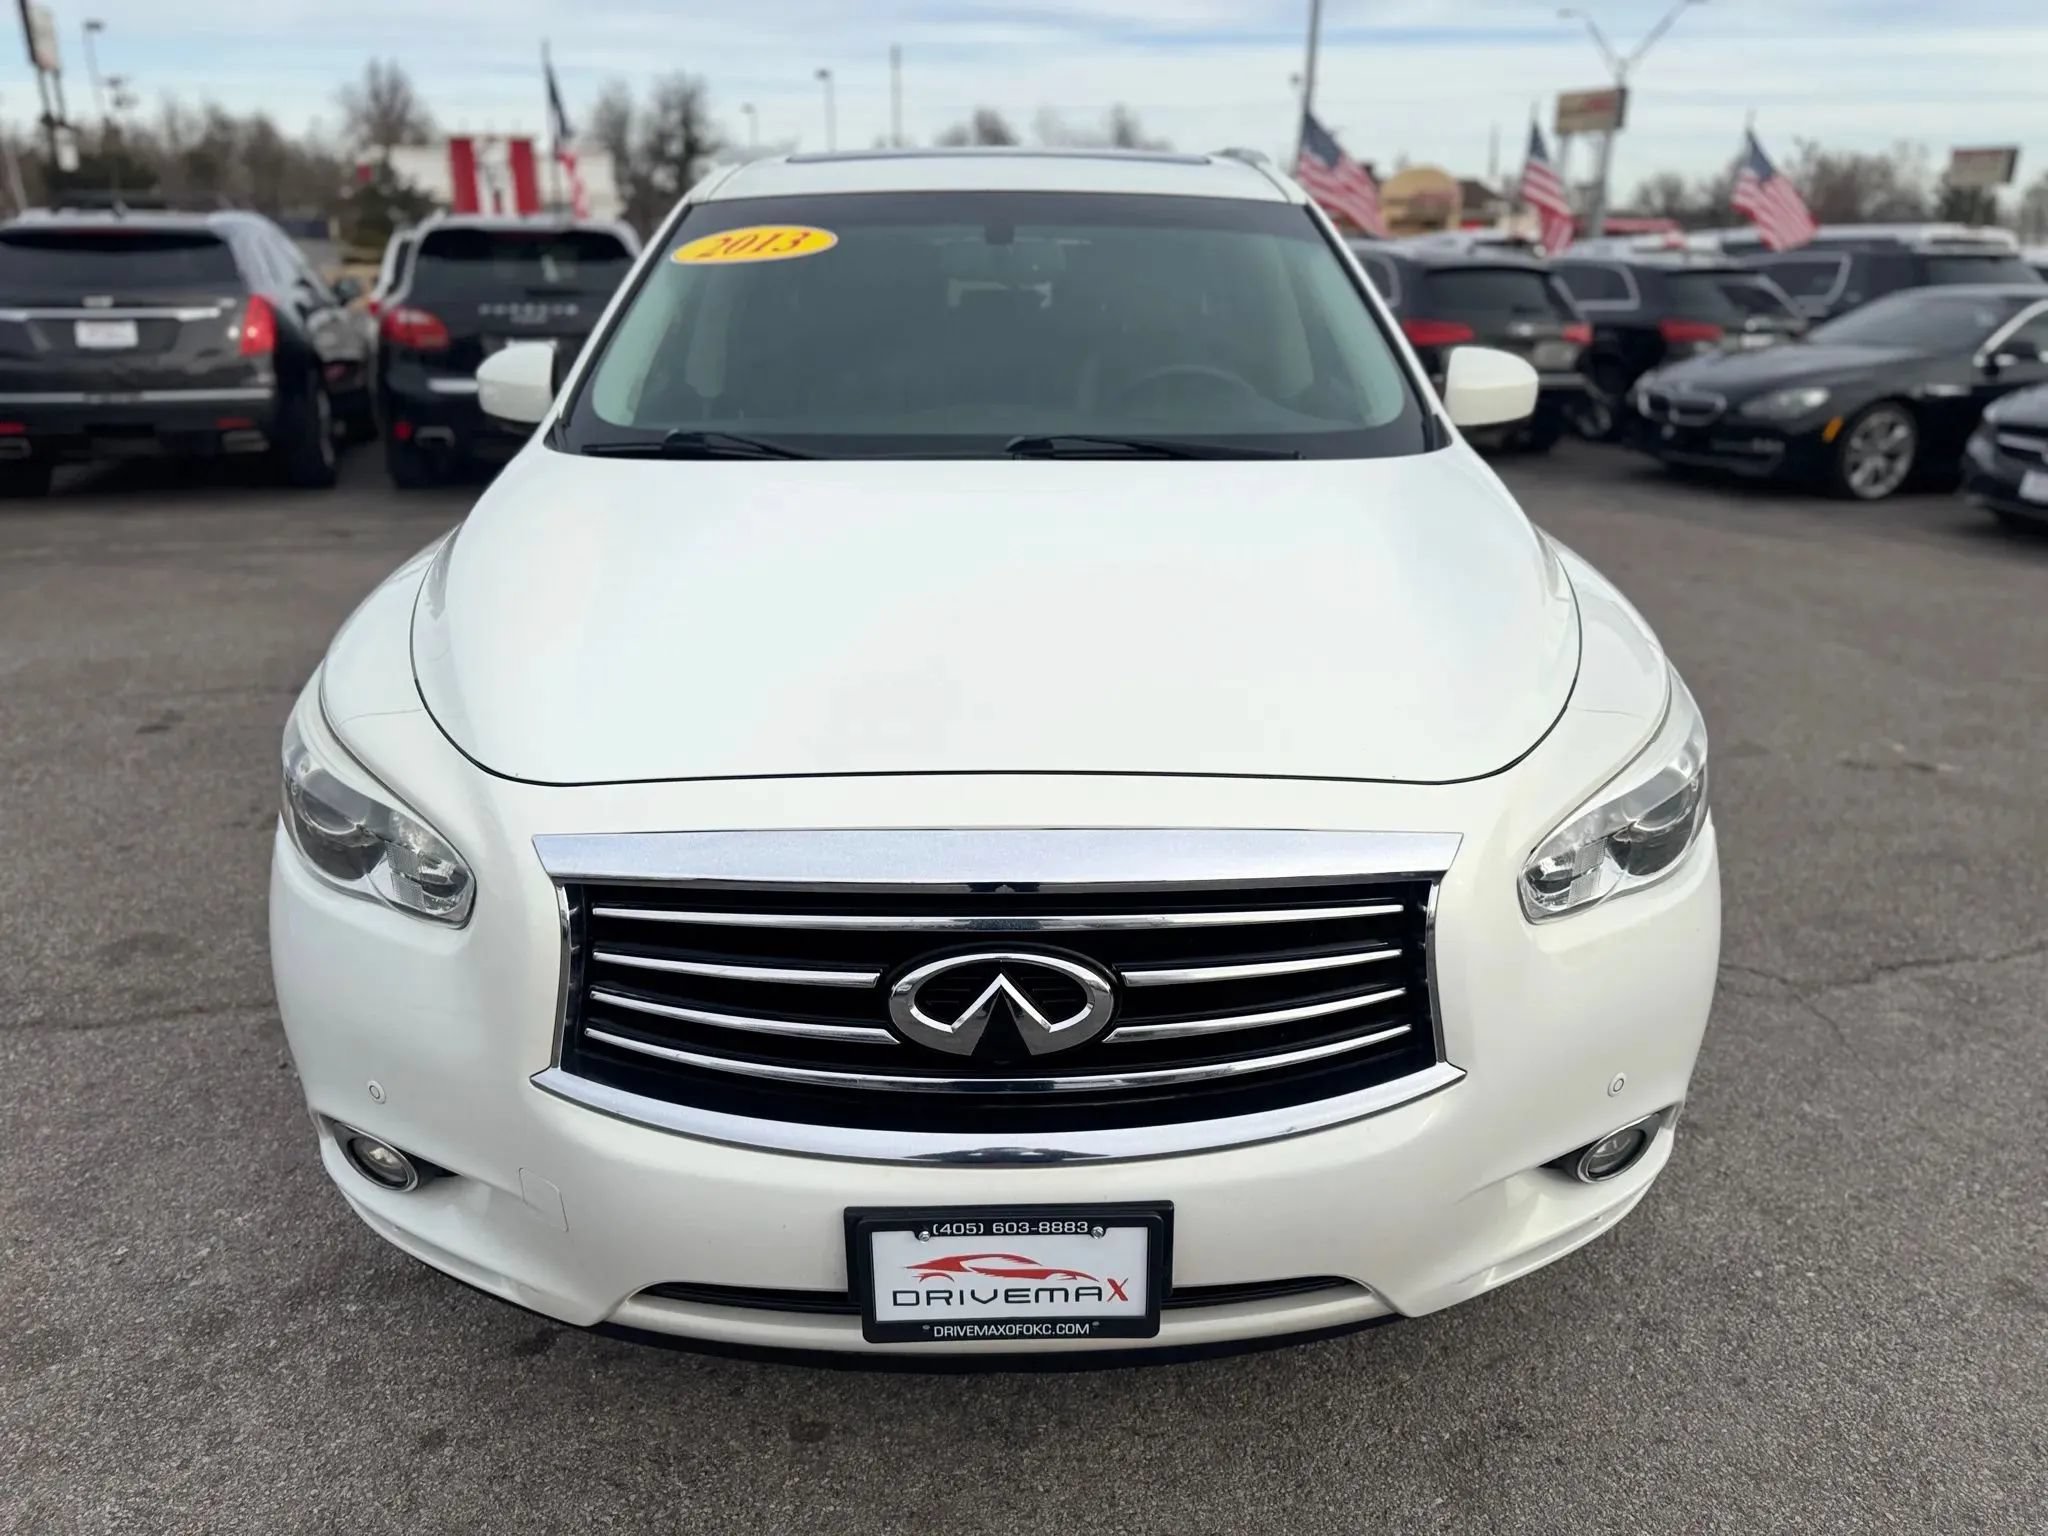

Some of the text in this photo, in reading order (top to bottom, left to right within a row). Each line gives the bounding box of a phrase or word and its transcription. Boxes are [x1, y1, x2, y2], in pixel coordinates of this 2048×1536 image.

[696, 231, 811, 260] 2013
[932, 1221, 1088, 1235] (405) 603-8883
[892, 1277, 1129, 1307] DRIVEMAX
[933, 1323, 1090, 1338] DRIVEMAXOFOKC.COM
